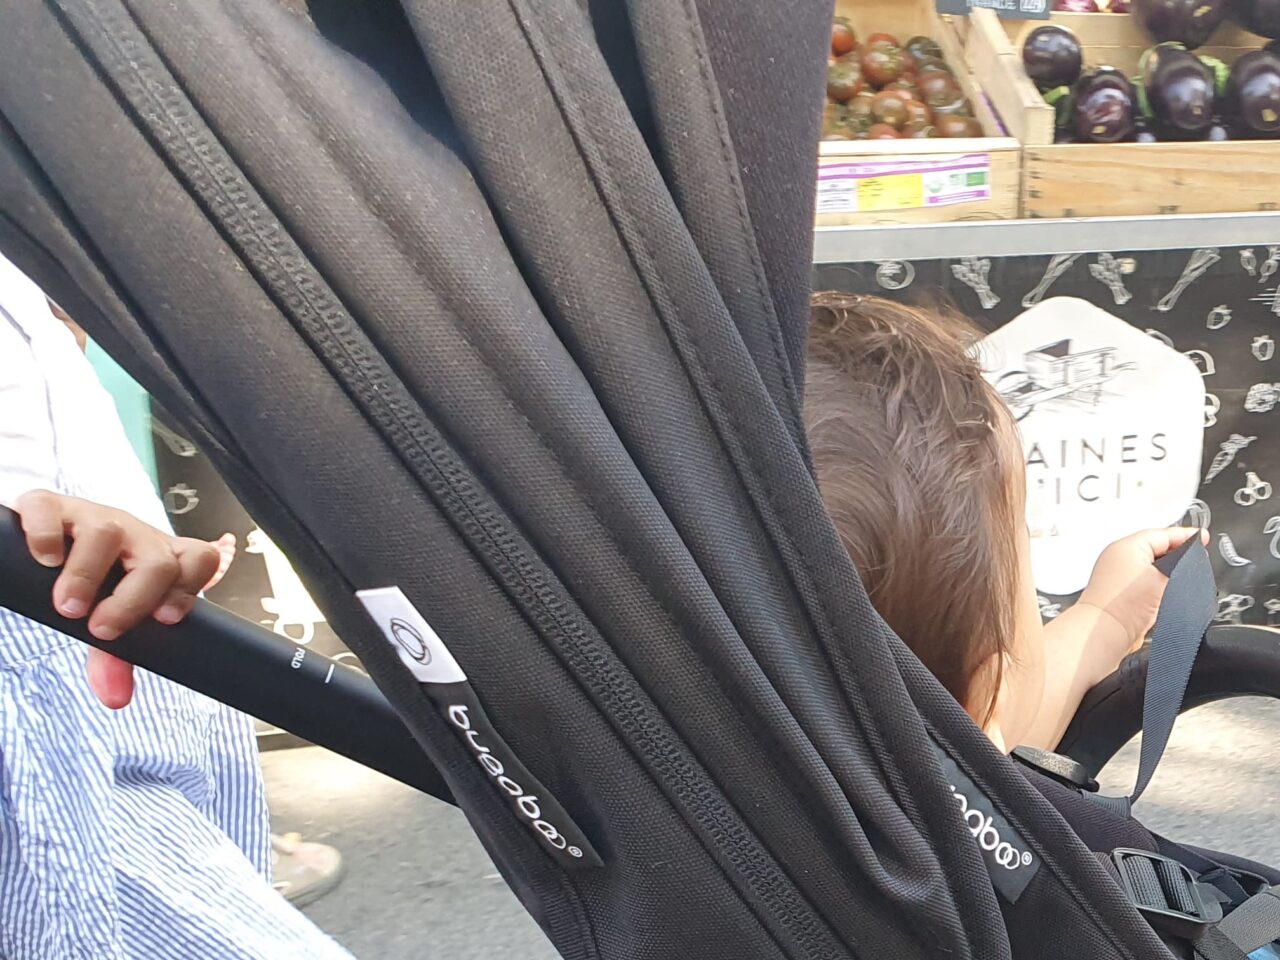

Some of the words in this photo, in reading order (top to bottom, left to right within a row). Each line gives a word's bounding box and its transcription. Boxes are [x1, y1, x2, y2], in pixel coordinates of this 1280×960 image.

[1025, 432, 1168, 469] AINES
[1037, 472, 1122, 505] 'ICI
[291, 647, 306, 669] FOLD
